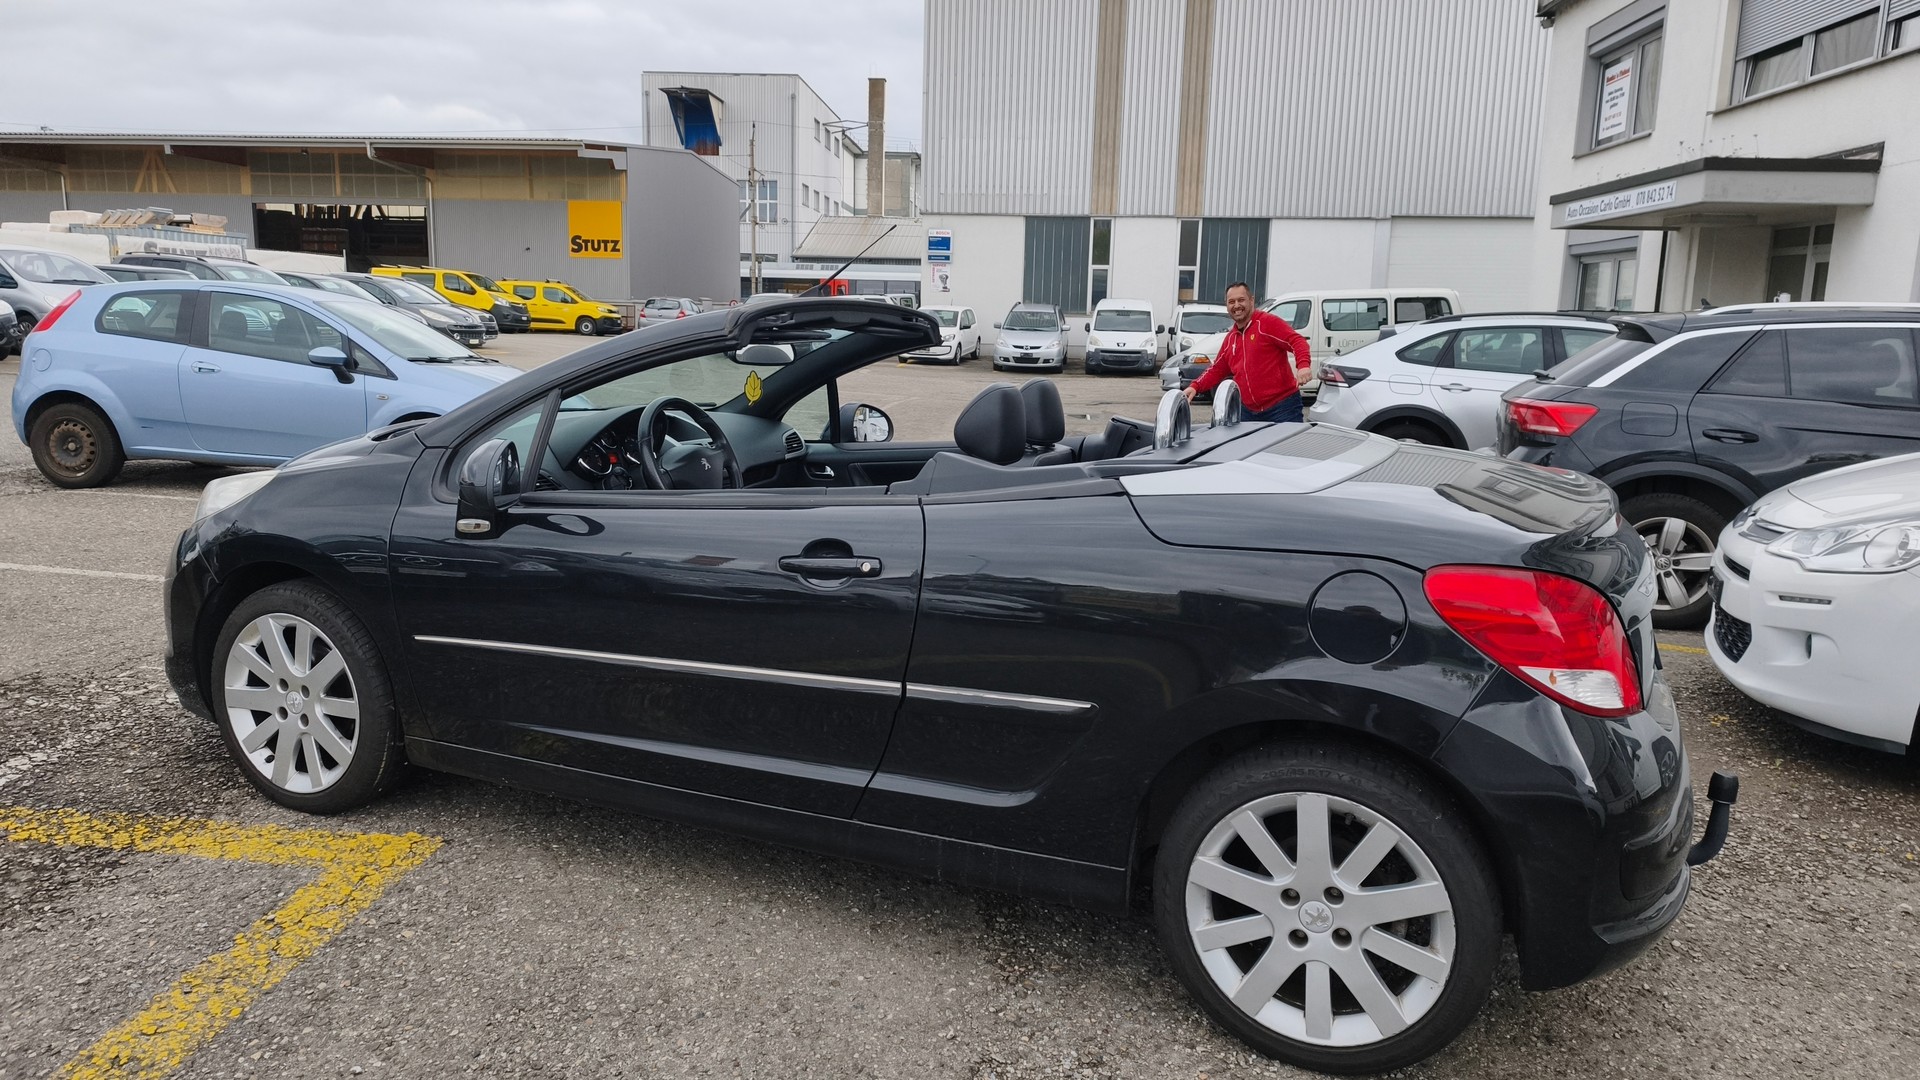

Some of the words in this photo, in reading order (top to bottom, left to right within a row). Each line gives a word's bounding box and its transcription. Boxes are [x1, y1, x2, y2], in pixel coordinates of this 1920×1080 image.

[1567, 207, 1578, 217] Auto
[1579, 204, 1599, 217] Occasion
[1600, 199, 1613, 213] Carlo
[1614, 196, 1631, 210] GmbH
[1636, 191, 1646, 206] 078
[1646, 188, 1657, 204] 842
[1658, 186, 1665, 202] 52
[1666, 184, 1674, 200] 74
[571, 234, 621, 253] STUTZ
